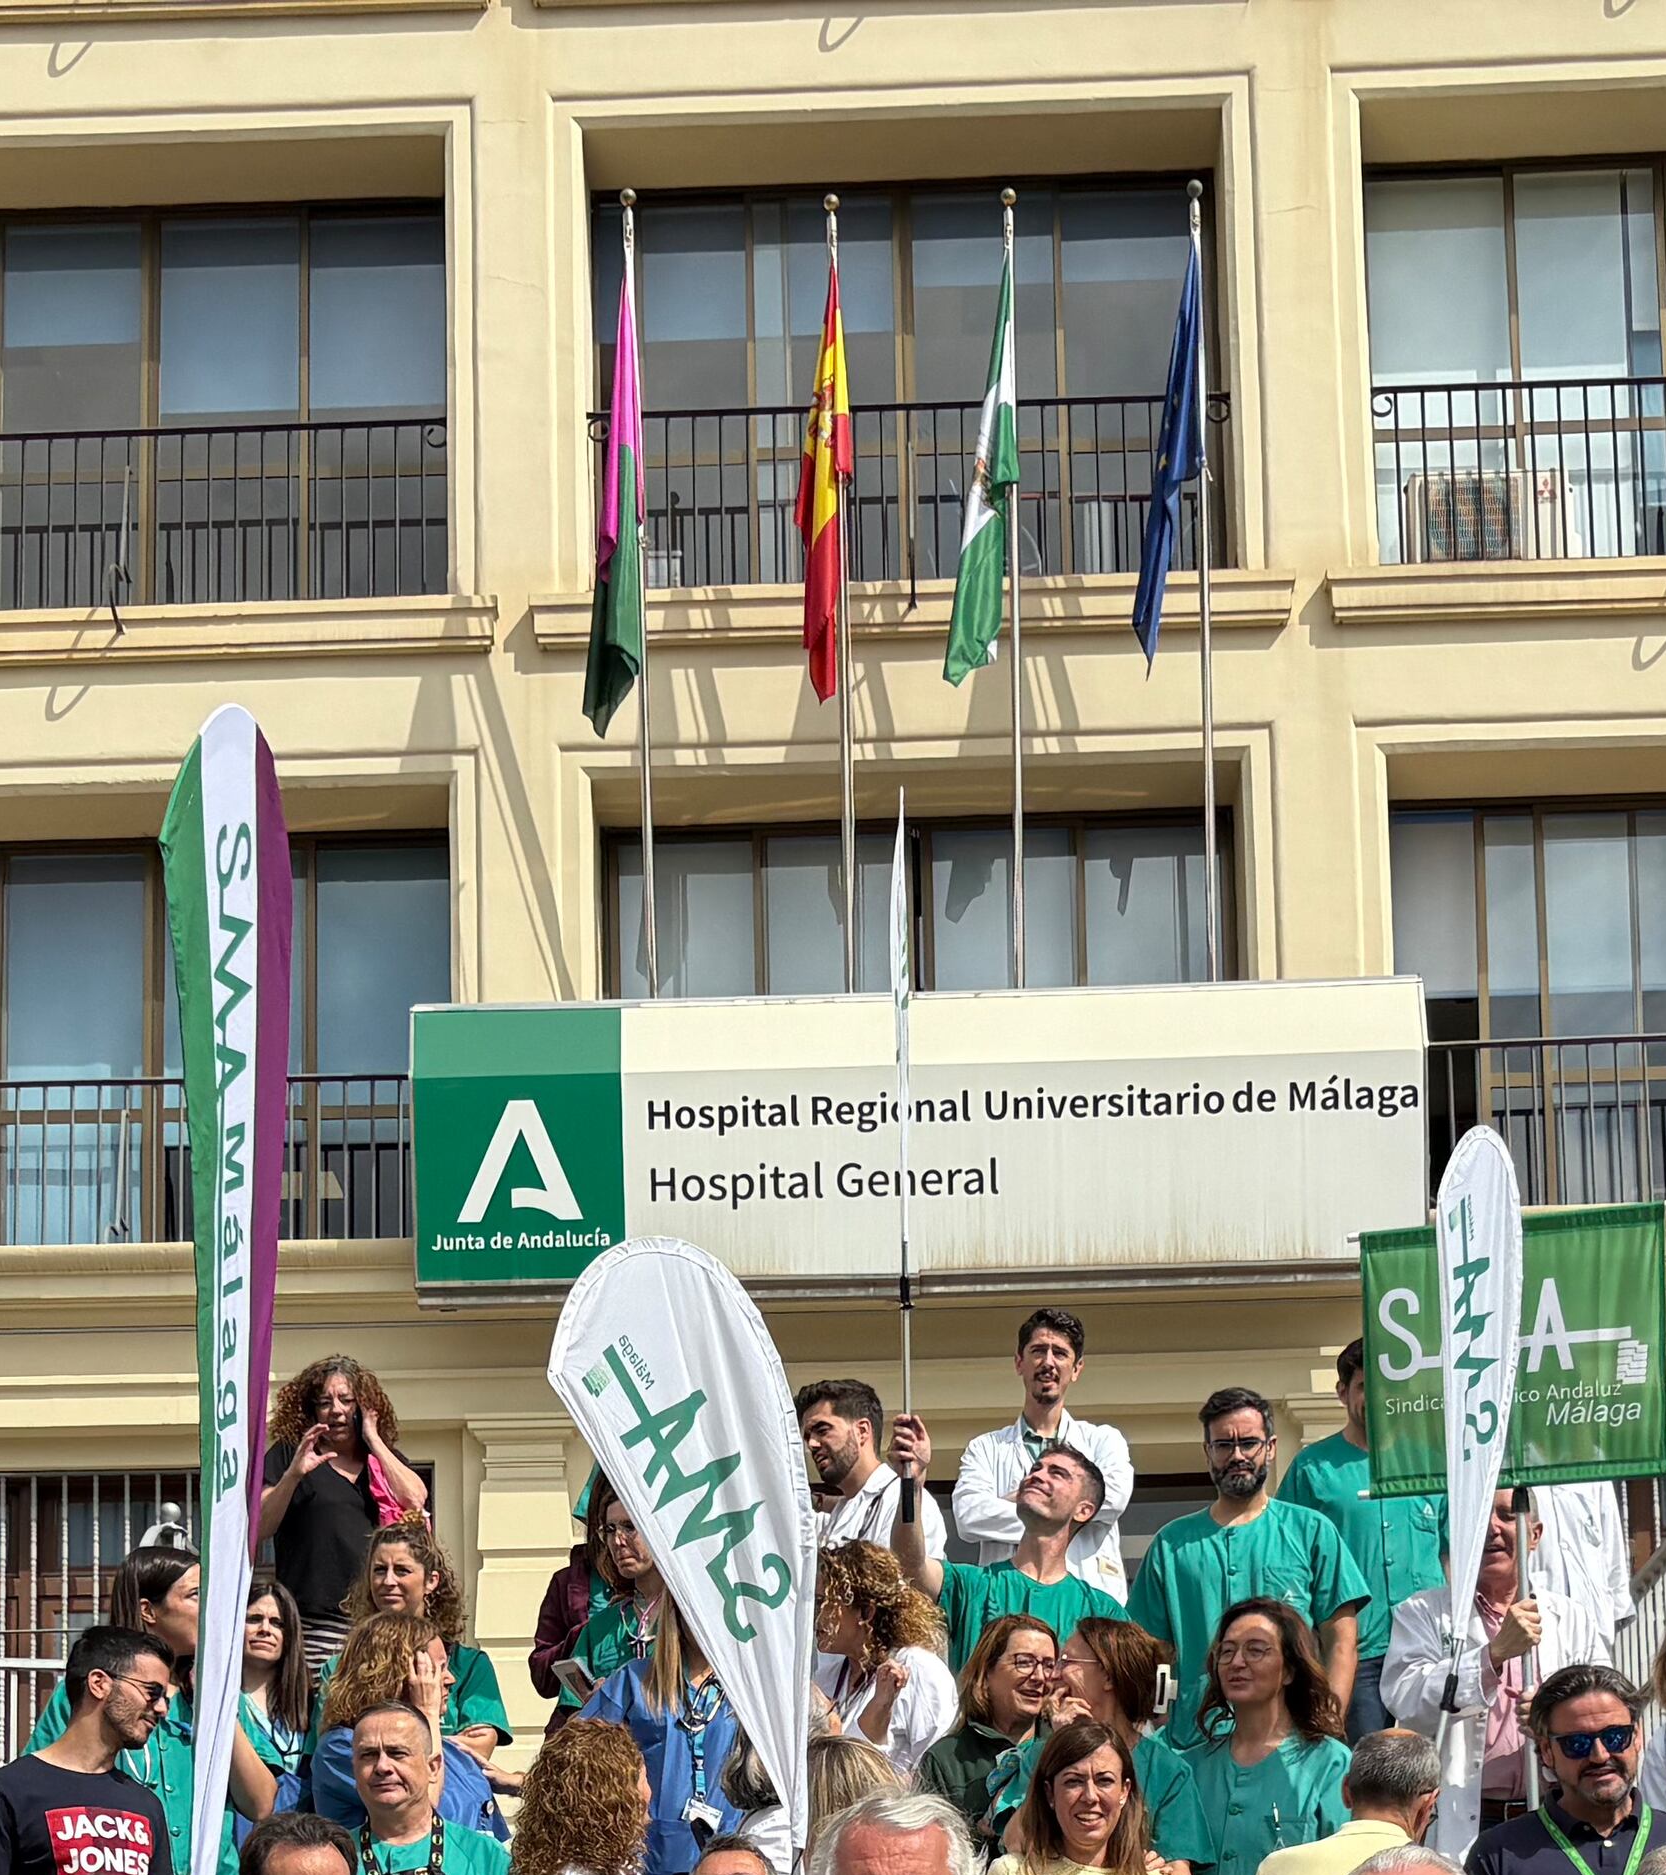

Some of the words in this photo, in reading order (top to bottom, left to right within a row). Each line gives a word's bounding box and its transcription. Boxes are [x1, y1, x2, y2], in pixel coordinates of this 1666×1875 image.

[646, 1094, 800, 1135] Hospital
[811, 1090, 971, 1132] Regional
[984, 1083, 1224, 1122] Universitario
[1231, 1079, 1277, 1114] de
[1288, 1074, 1419, 1118] Málaga
[648, 1160, 824, 1211] Hospital
[835, 1157, 999, 1201] General
[431, 1229, 484, 1251] Junta
[488, 1229, 512, 1249] de
[517, 1226, 611, 1249] Andalucía
[216, 1122, 245, 1491] Málaga
[1378, 1277, 1574, 1380] SA
[1546, 1380, 1623, 1400] Andaluz
[1546, 1401, 1642, 1427] Málaga
[56, 1815, 149, 1845] JACK&
